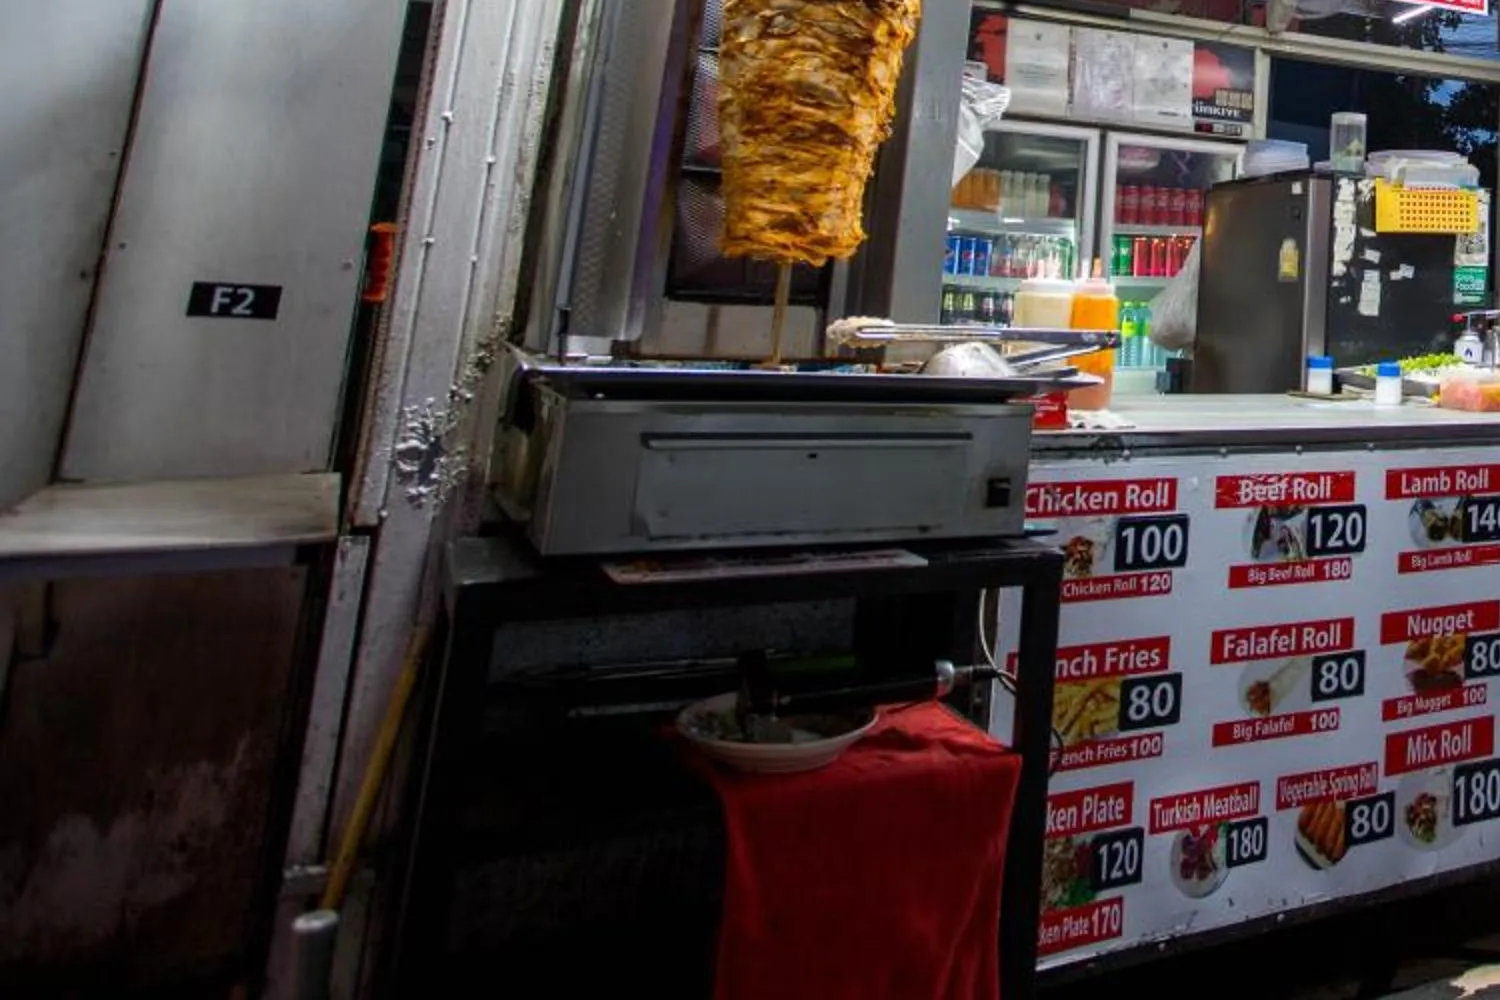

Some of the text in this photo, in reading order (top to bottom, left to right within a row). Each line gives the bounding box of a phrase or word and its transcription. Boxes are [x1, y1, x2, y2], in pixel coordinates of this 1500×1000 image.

[210, 286, 256, 316] F2
[1239, 476, 1332, 504] Beef Roll
[1400, 468, 1489, 495] Lamb Roll
[1024, 485, 1169, 514] Chicken Roll
[1121, 522, 1183, 565] 100
[1309, 512, 1363, 549] 120
[1247, 560, 1350, 585] Big Beef Roll 180
[1427, 552, 1453, 567] Lamb
[1453, 550, 1472, 564] Roll
[1062, 573, 1172, 598] Chicken Roll 120
[1406, 609, 1474, 637] Nugget
[1222, 625, 1342, 659] Falafel Roll
[1055, 645, 1161, 678] nch Fries
[1319, 658, 1361, 692] 80
[1128, 681, 1175, 721] 80
[1396, 686, 1486, 715] Big Nugget 100
[1232, 713, 1338, 740] Big Falafel 100
[1096, 738, 1163, 761] Fries 100
[1406, 723, 1473, 766] Mix Roll
[1328, 770, 1359, 800] Spring
[1359, 764, 1377, 789] Roll
[1454, 769, 1500, 819] 180
[1081, 795, 1125, 821] Plate
[1153, 785, 1257, 826] Turkish Meatball
[1351, 800, 1390, 838] 80
[1229, 825, 1264, 860] 180
[1098, 843, 1140, 882] 120
[1062, 918, 1090, 937] Plate
[1090, 904, 1120, 936] 170
